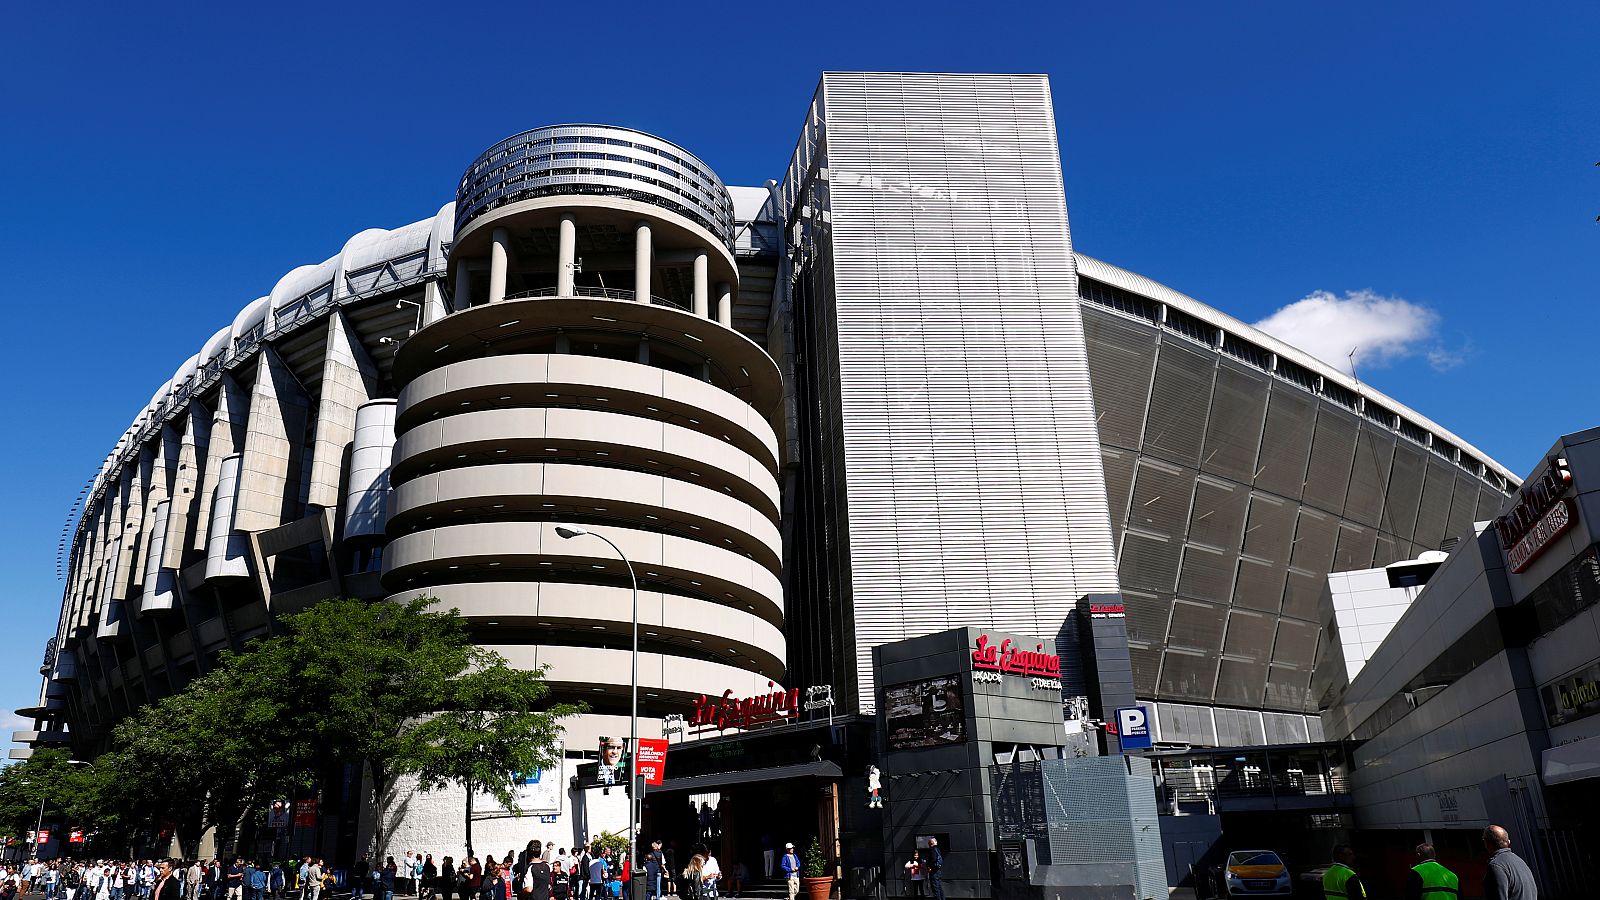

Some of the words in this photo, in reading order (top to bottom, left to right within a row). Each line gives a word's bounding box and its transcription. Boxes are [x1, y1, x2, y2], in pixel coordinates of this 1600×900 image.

[972, 635, 997, 662] La
[1000, 639, 1061, 675] Esquina
[974, 671, 1003, 682] ASADOR
[688, 694, 715, 727] La
[717, 681, 799, 731] Esquina
[1557, 685, 1570, 708] la
[1570, 678, 1599, 713] plaza
[1120, 709, 1145, 736] P
